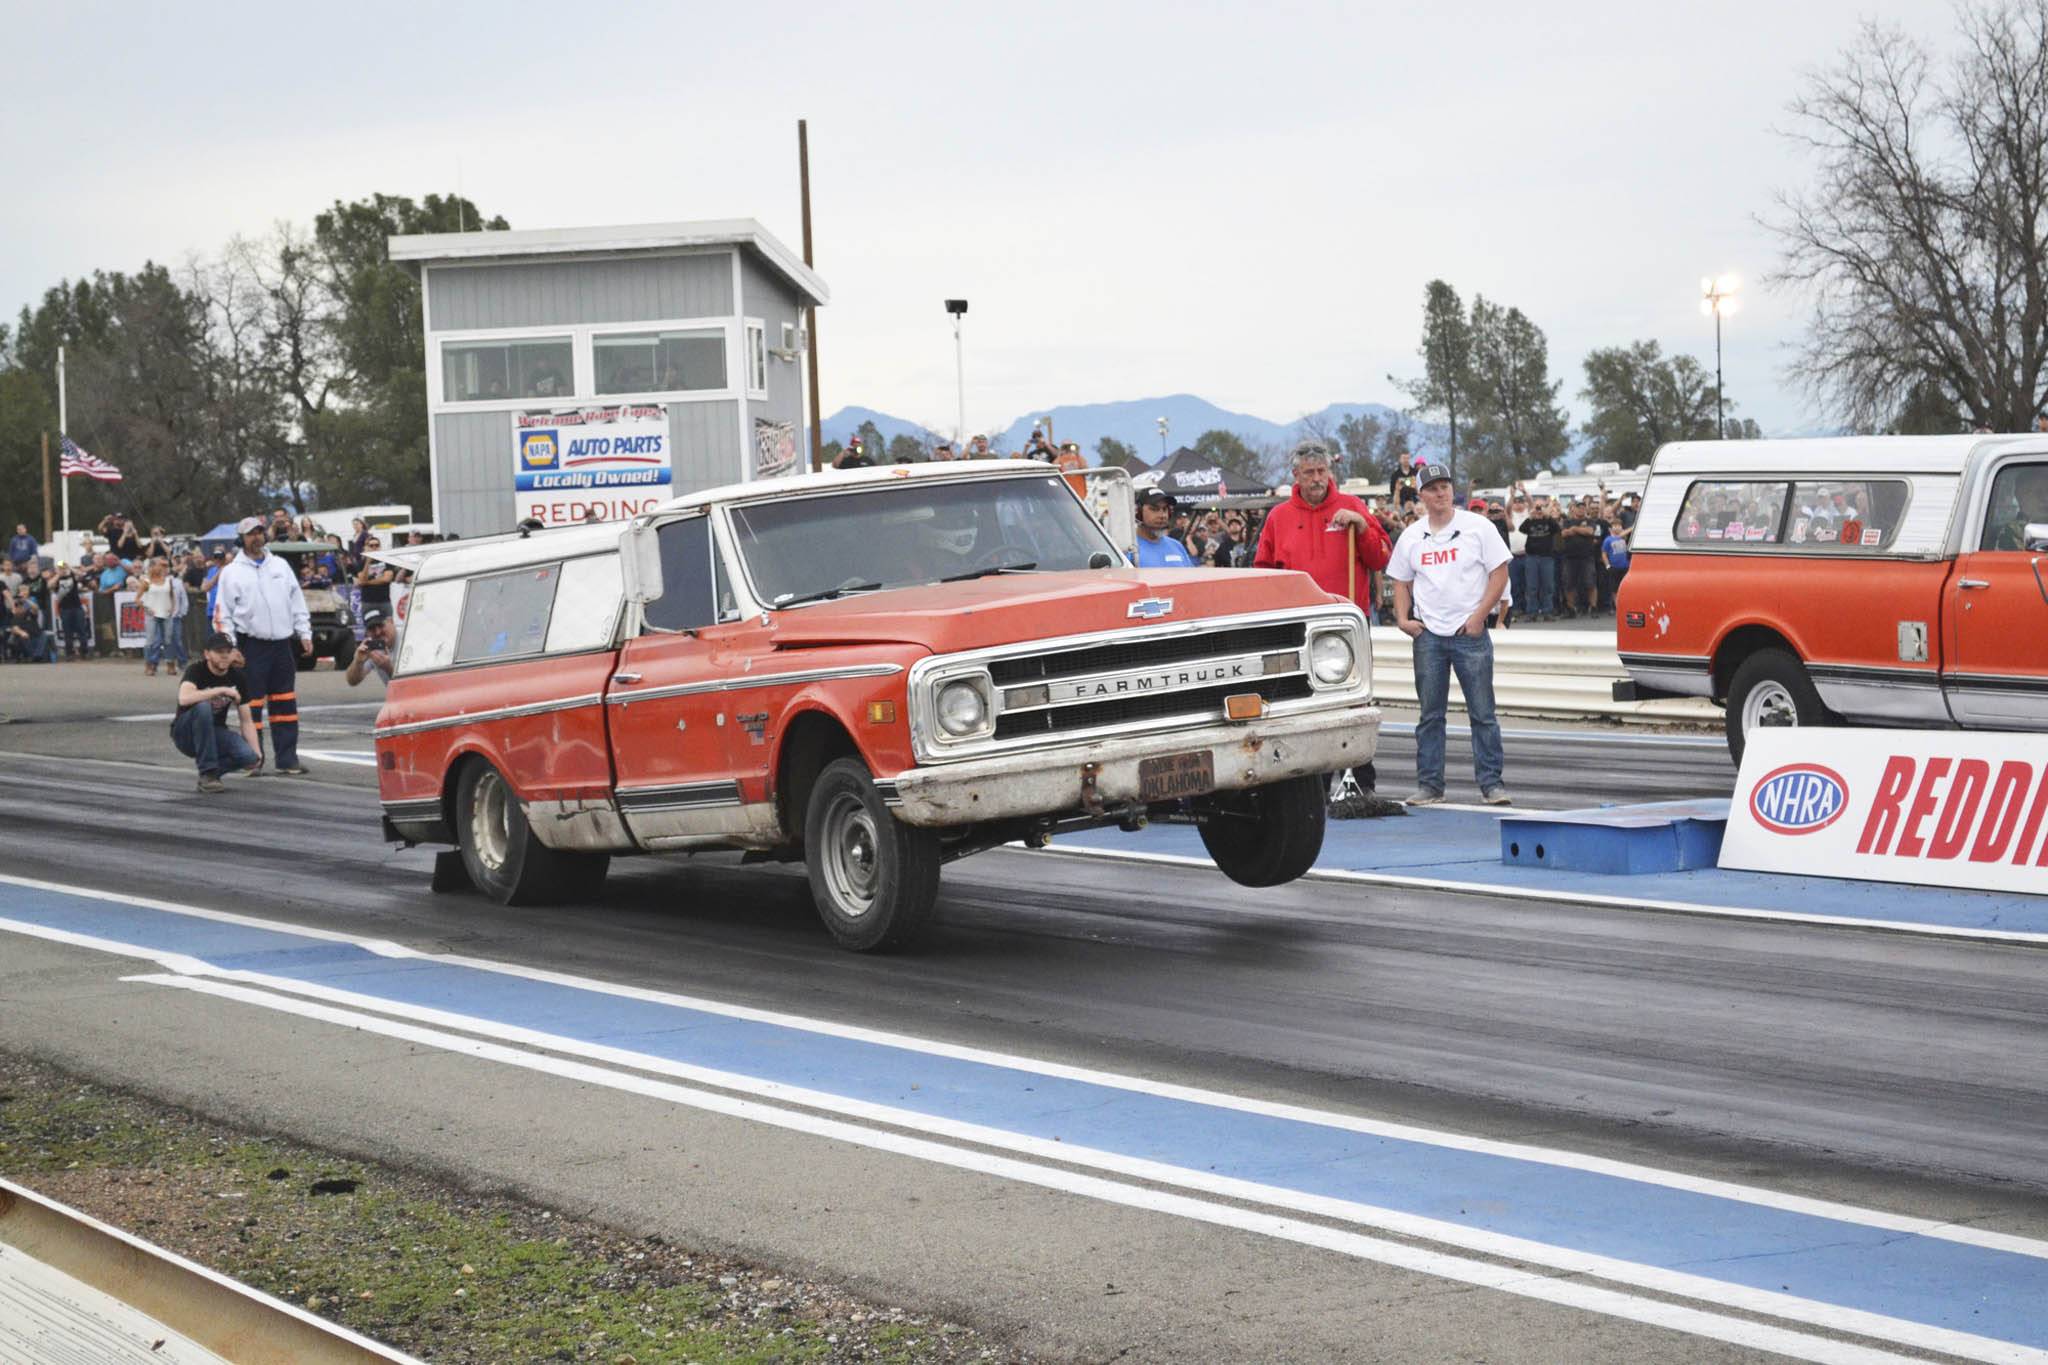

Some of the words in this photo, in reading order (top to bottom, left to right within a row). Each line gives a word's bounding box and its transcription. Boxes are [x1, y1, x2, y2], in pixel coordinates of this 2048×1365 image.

[528, 443, 551, 457] NAPA
[567, 437, 610, 457] AUTO
[613, 435, 662, 454] PARTS
[533, 471, 593, 488] Locally
[595, 469, 660, 486] Owned!
[1421, 548, 1458, 566] EMT
[1076, 664, 1243, 697] FARMTRUCK
[1143, 770, 1212, 799] OKLAHOMA
[1762, 774, 1834, 825] NHRA
[1856, 755, 2048, 867] REDDI
